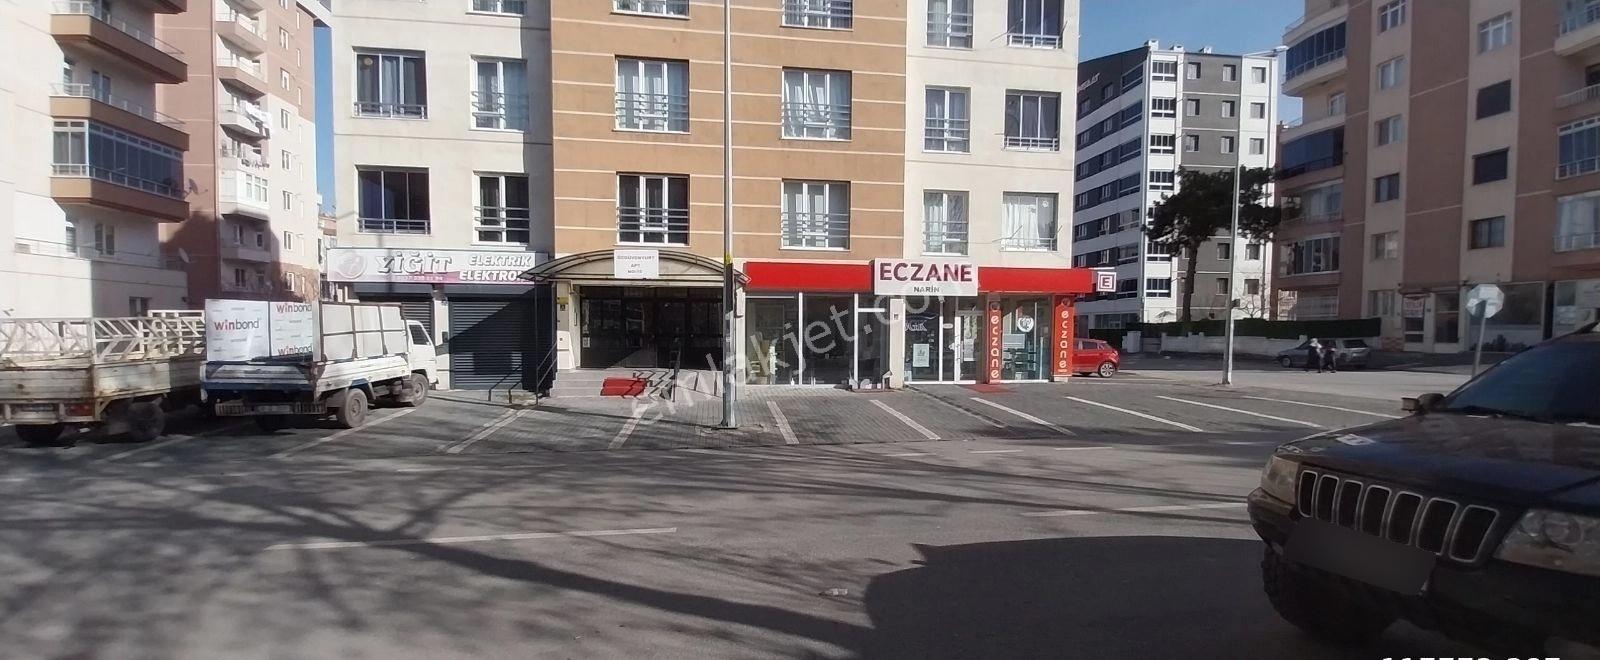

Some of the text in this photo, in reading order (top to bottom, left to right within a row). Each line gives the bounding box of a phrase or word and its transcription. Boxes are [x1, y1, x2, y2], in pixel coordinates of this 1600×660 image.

[375, 250, 452, 274] YİĞİT
[880, 262, 973, 282] ECZANE
[1102, 276, 1111, 288] E
[214, 318, 260, 331] winbond
[990, 315, 1000, 379] eczane
[1059, 310, 1069, 369] eczane
